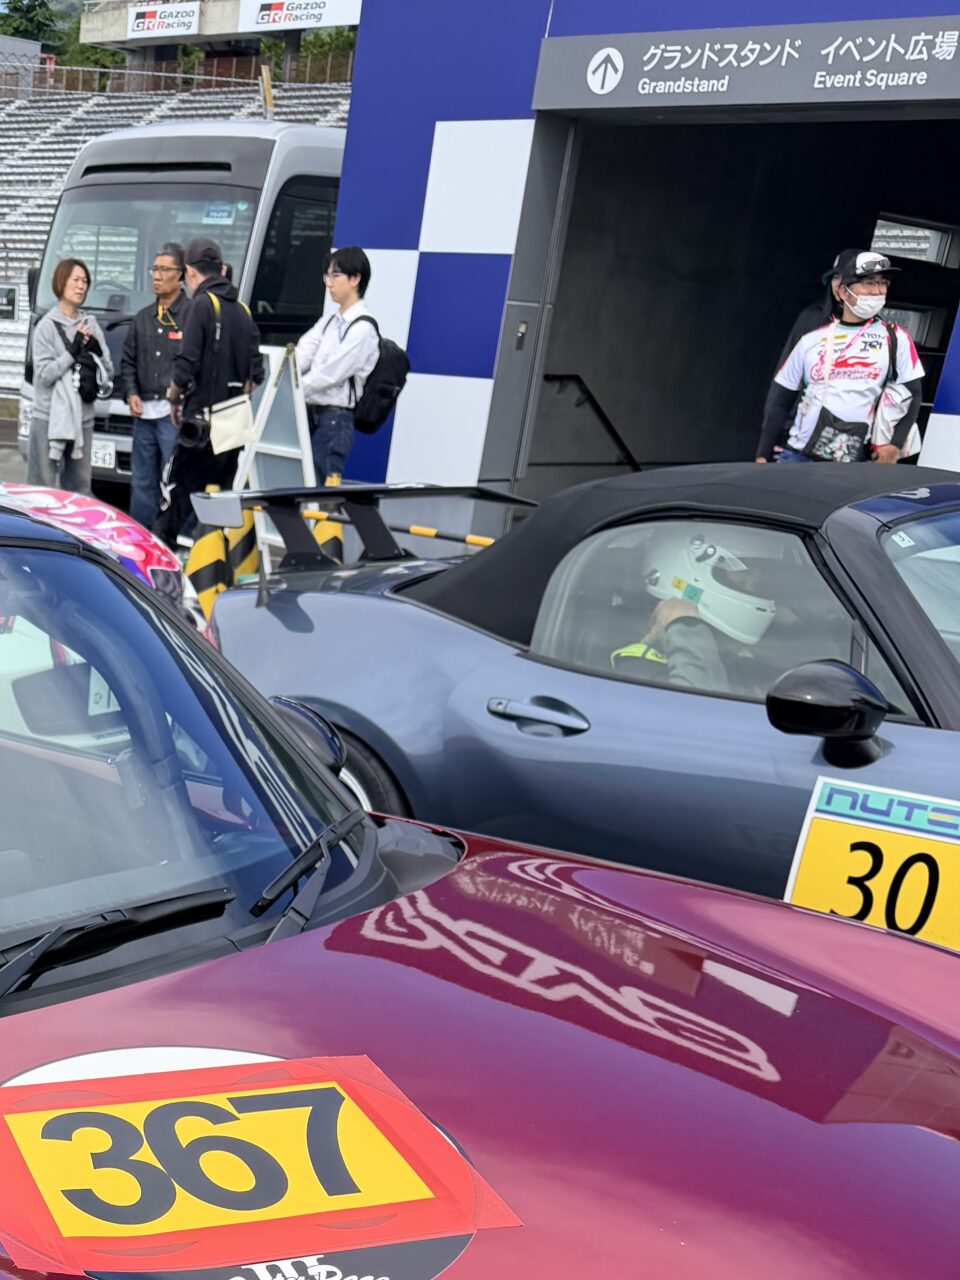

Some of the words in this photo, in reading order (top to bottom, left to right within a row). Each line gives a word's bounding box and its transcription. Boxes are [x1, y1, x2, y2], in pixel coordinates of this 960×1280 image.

[158, 10, 195, 20] GAZOO
[286, 1, 326, 11] GAZOO
[157, 20, 193, 31] Racing
[283, 11, 323, 22] Racing
[642, 39, 802, 72] グランドスタンド
[820, 31, 959, 65] イベント広場
[638, 75, 730, 95] Grandstand
[813, 72, 862, 89] Event
[863, 69, 928, 88] Square
[829, 841, 940, 936] 30
[40, 1086, 362, 1226] 367
